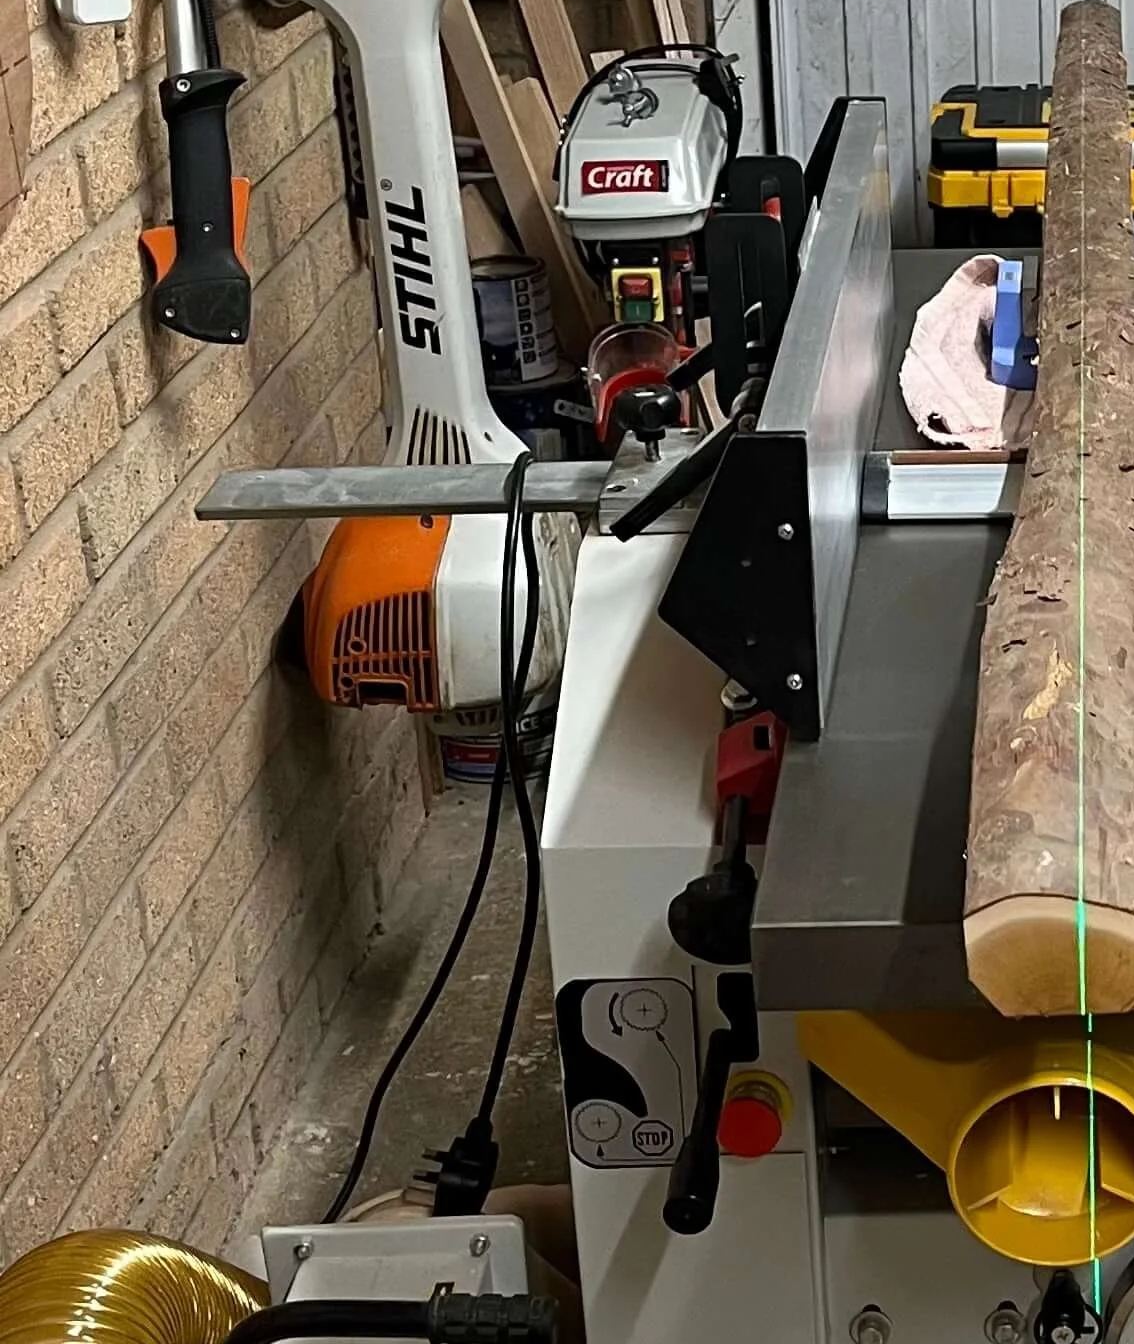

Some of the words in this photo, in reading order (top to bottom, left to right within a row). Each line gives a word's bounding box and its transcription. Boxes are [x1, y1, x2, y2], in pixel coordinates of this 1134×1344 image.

[587, 164, 654, 189] Craft
[384, 185, 443, 355] STIHL
[637, 1131, 668, 1146] STOP
